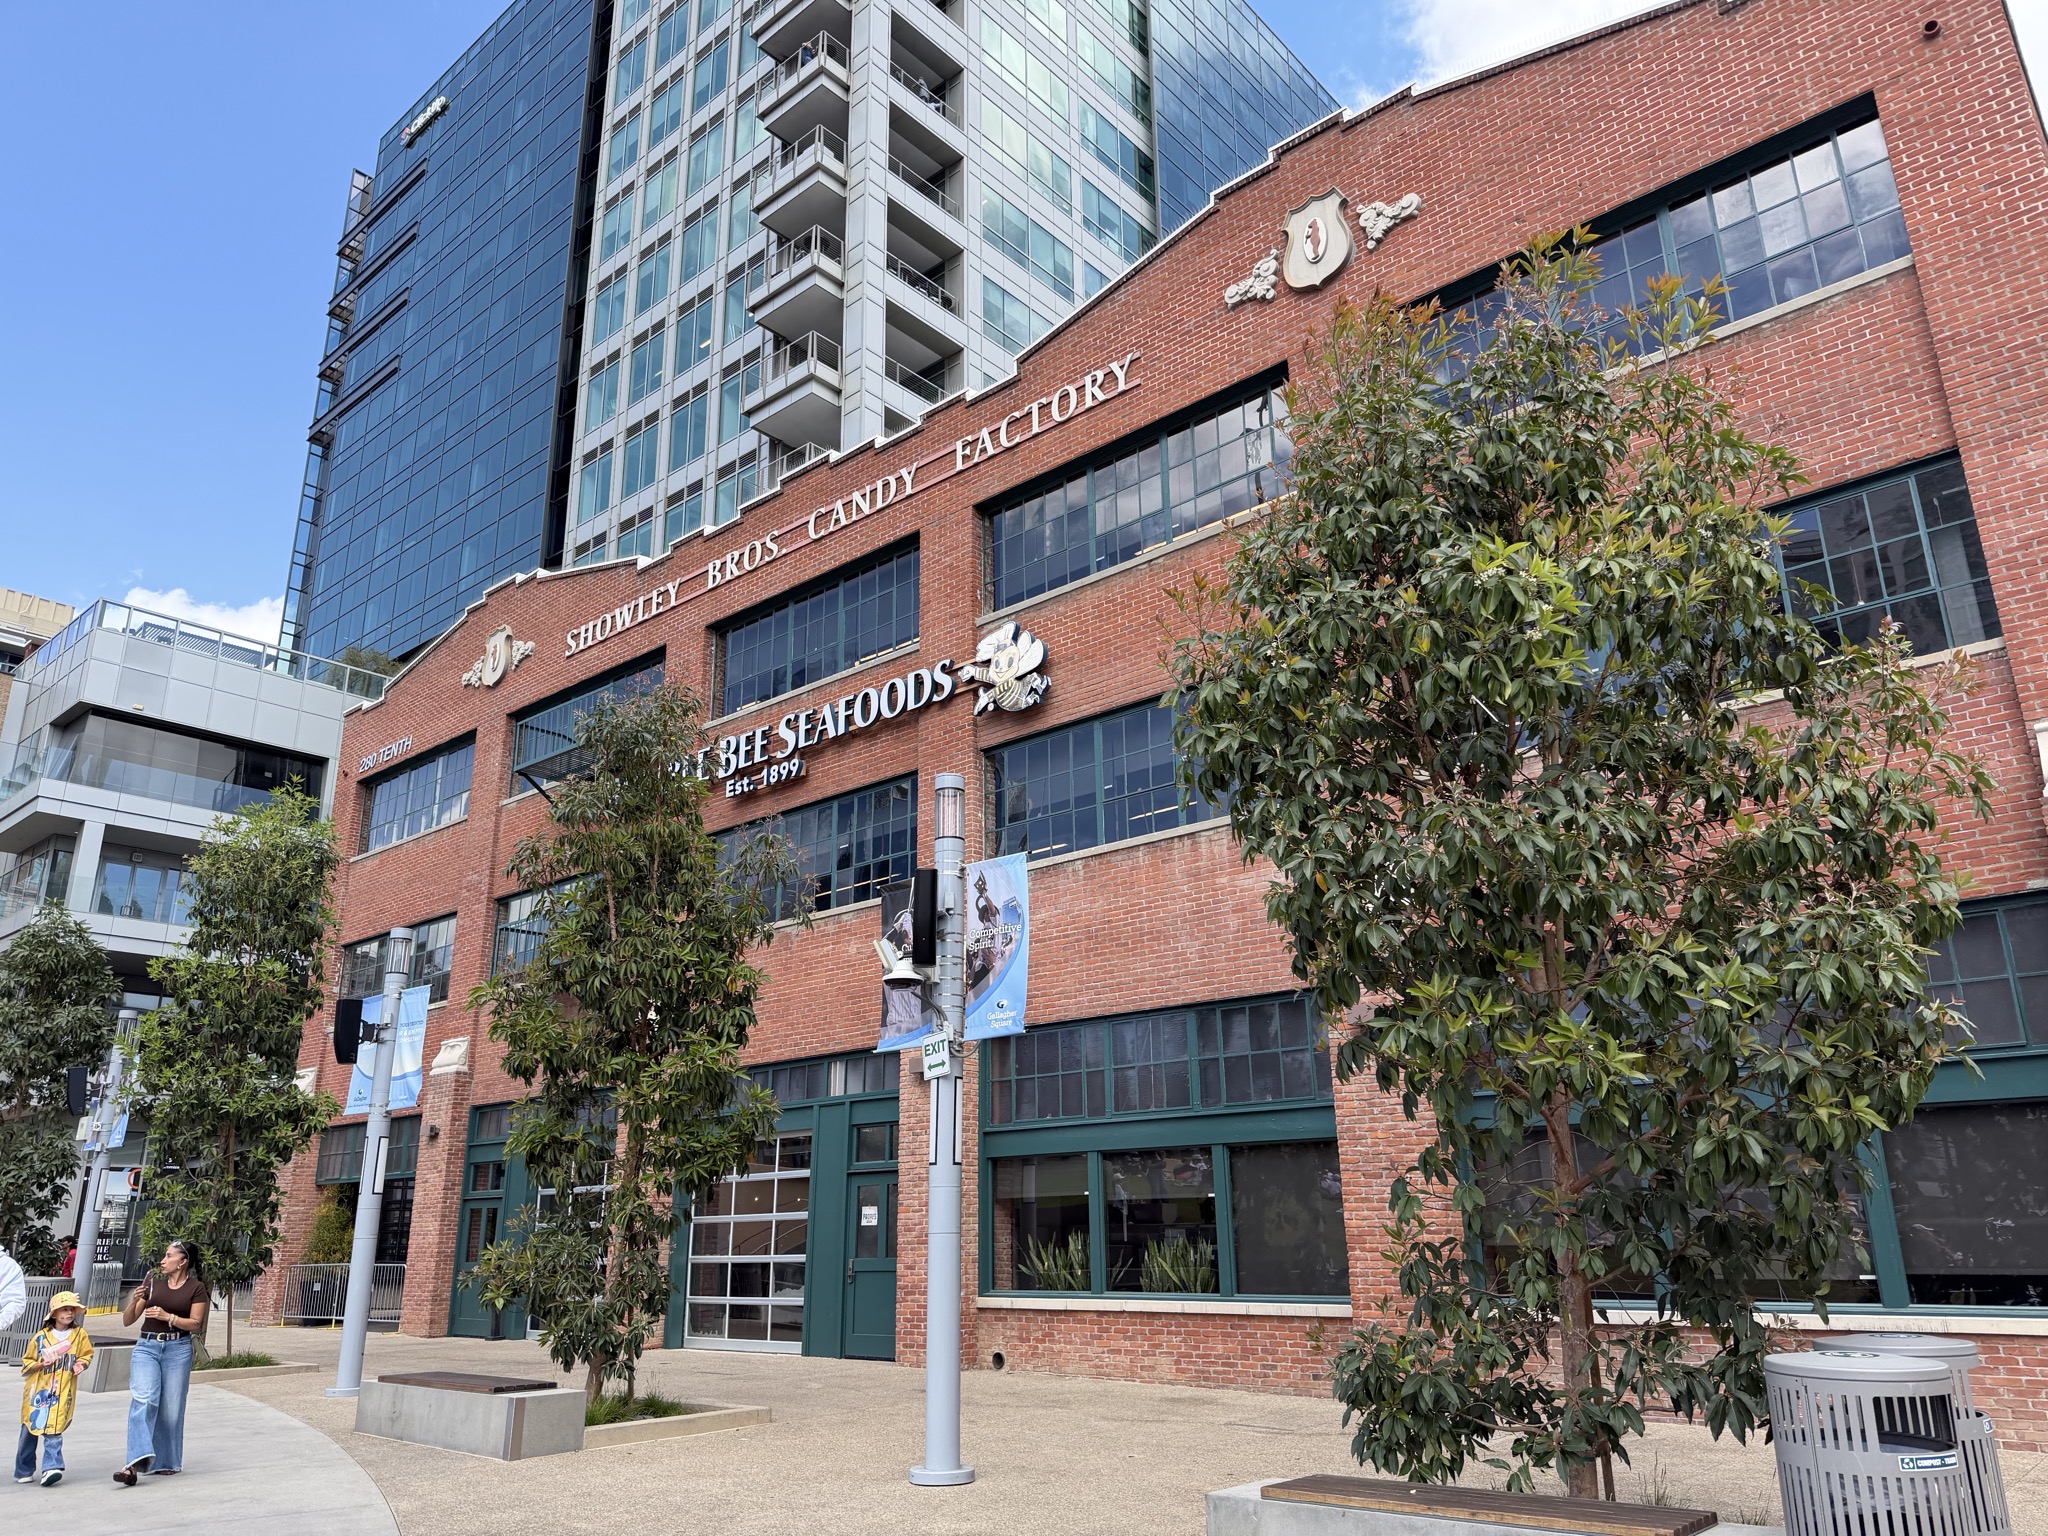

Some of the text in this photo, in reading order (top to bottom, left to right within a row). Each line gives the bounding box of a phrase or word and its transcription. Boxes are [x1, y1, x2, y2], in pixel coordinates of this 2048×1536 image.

[565, 352, 1134, 657] SHOWLEY BROS. CANDY FACTORY
[718, 725, 772, 779] BEE
[776, 659, 955, 759] SEAFOODS
[359, 735, 413, 773] 280 TENTH
[725, 758, 801, 798] Est. 1899
[969, 924, 1022, 940] Competitive
[969, 939, 994, 954] Spirit.
[987, 1010, 1017, 1020] Gallagher
[990, 1019, 1013, 1029] Square
[924, 1038, 946, 1057] EXIT
